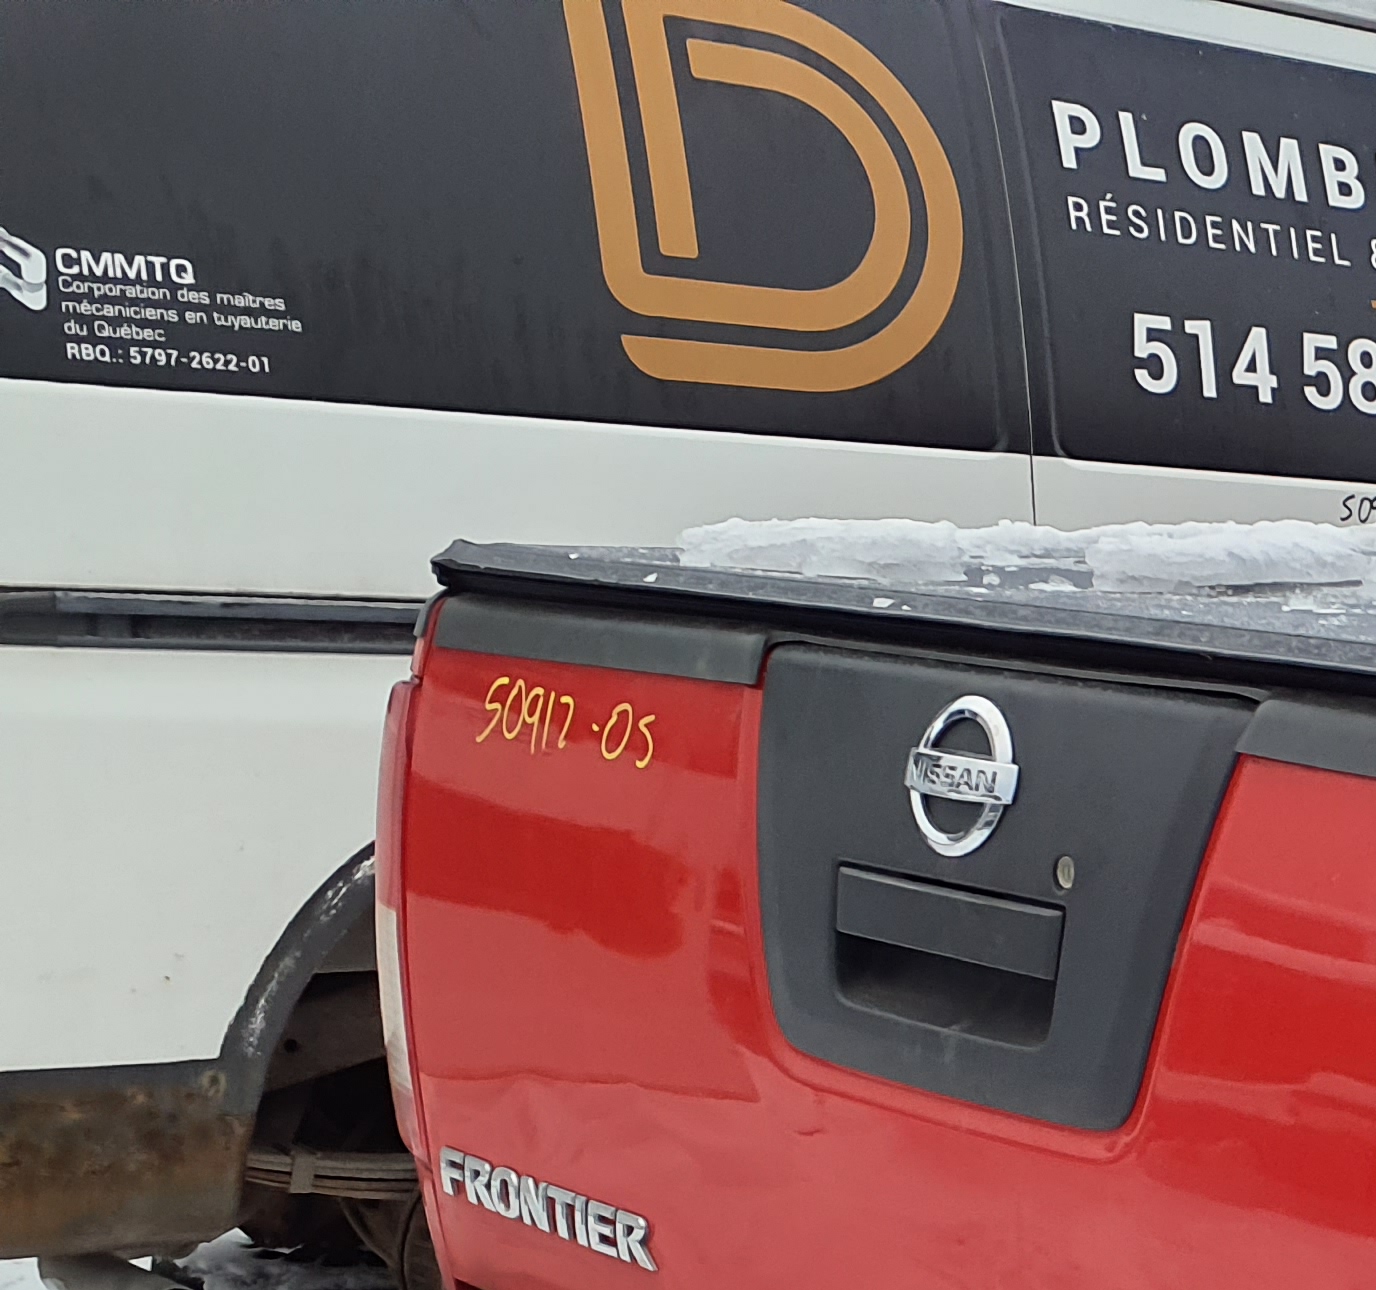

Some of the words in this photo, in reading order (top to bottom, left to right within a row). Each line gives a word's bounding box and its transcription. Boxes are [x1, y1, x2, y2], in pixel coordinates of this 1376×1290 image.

[1067, 193, 1352, 267] RÉSIDENTIEL
[55, 247, 195, 284] CMMTQ
[58, 276, 171, 301] Corporation
[177, 287, 210, 305] des
[216, 292, 286, 311] maîtres
[61, 300, 179, 323] mécaniciens
[185, 311, 208, 325] en
[213, 311, 303, 333] tuyauterie
[63, 319, 88, 337] du
[94, 320, 167, 342] Québec
[129, 347, 271, 373] 5797-2622-01
[1132, 312, 1278, 404] 514
[911, 757, 998, 794] NISSAN
[439, 1145, 659, 1272] FRONTIER
